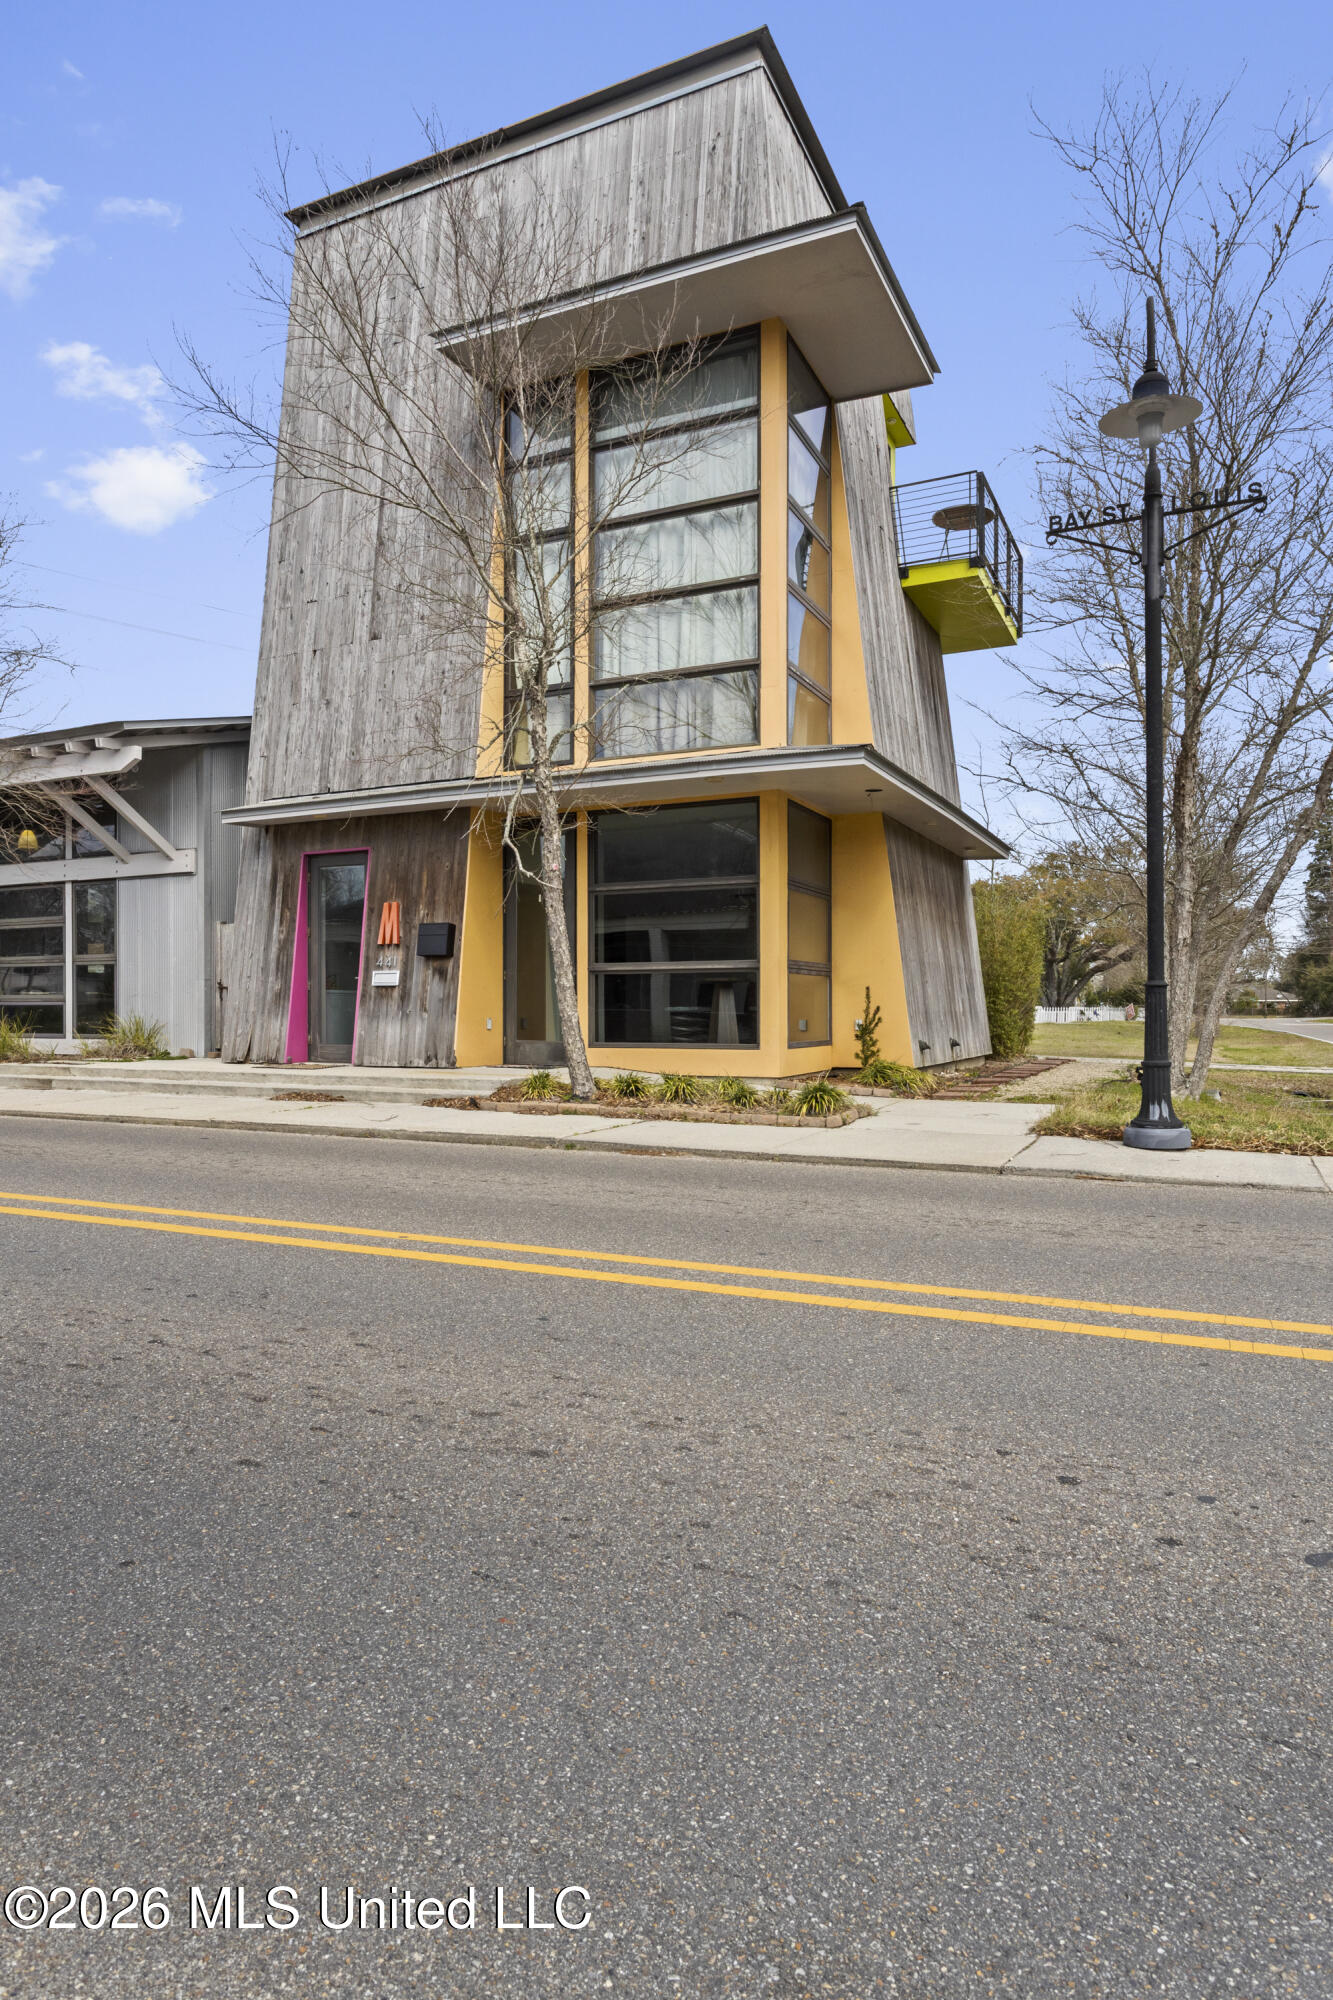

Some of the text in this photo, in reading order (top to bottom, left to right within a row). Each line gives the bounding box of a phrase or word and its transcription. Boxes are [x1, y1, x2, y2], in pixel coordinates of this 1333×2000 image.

[1049, 508, 1092, 531] BAY
[1171, 482, 1263, 511] LOUIS
[377, 902, 399, 945] M
[376, 953, 398, 968] 441
